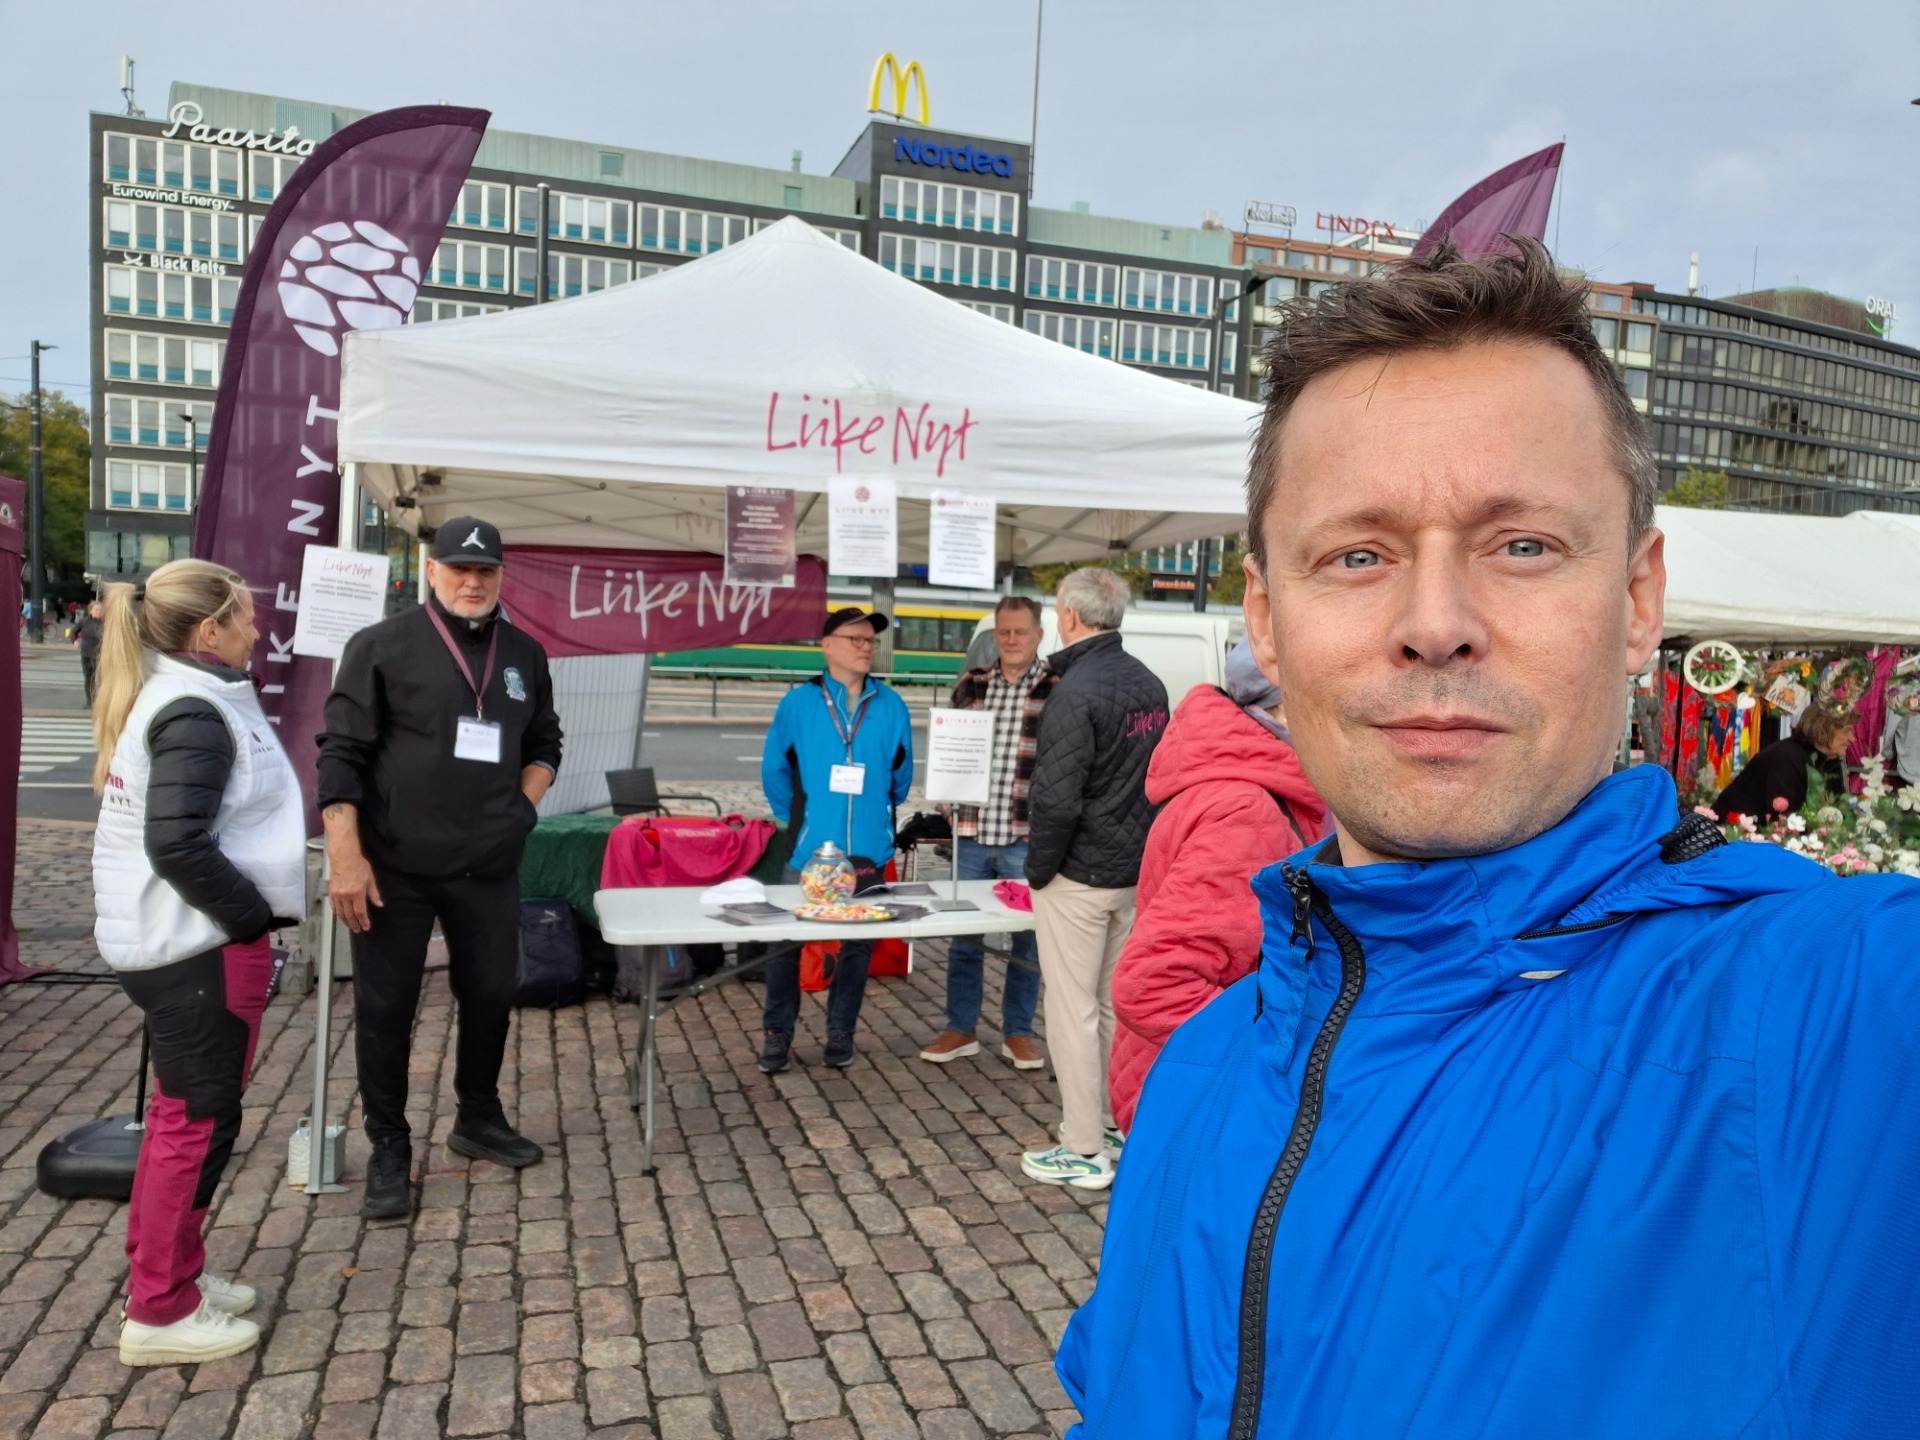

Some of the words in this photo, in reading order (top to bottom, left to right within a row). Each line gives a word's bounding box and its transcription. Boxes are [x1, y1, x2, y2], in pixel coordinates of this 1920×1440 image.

[161, 101, 316, 156] Paasita
[895, 134, 1014, 178] Nordea
[112, 183, 179, 203] Eurowind
[181, 193, 231, 211] Energy
[1316, 211, 1397, 241] LINDEX
[150, 254, 188, 272] Black
[191, 258, 226, 276] Belts
[1865, 296, 1899, 321] ORAL
[766, 391, 885, 474] Liike
[892, 402, 980, 478] Nyt
[287, 395, 340, 537] NYT
[570, 565, 689, 640] Liike
[697, 571, 773, 636] Nyt
